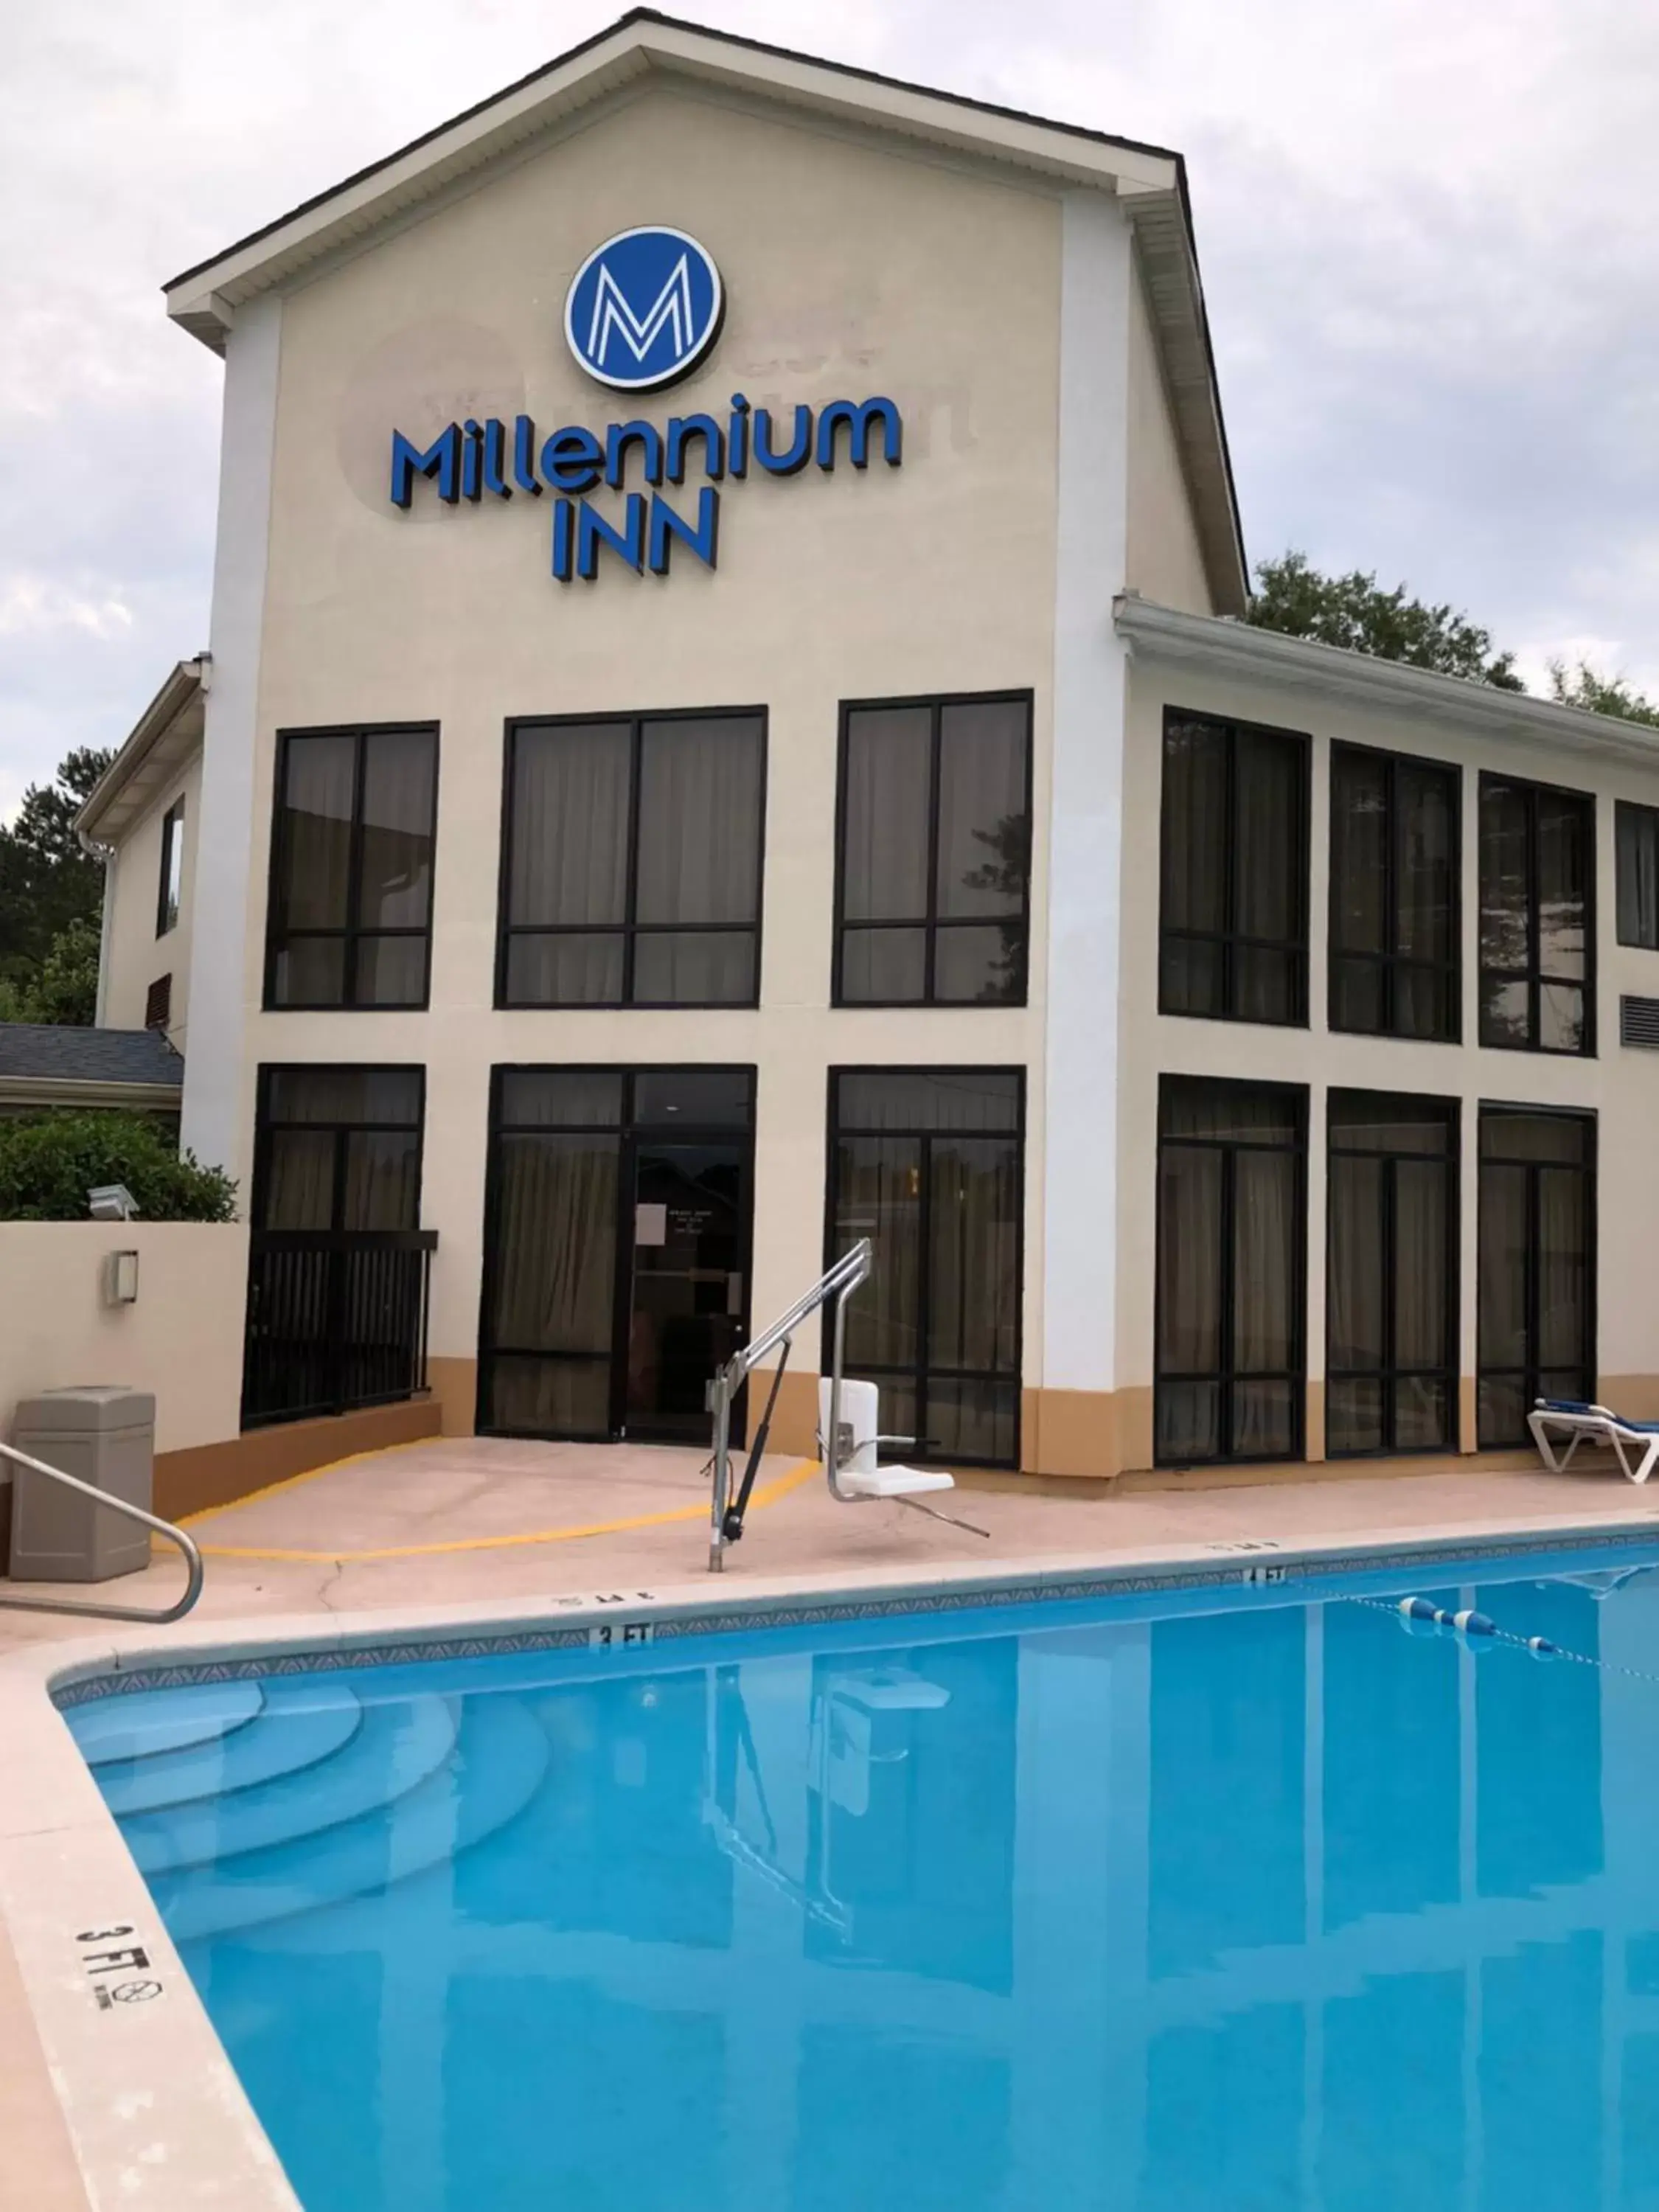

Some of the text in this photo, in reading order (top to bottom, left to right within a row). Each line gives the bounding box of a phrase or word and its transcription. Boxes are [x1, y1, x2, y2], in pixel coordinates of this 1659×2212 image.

[588, 252, 694, 366] M
[391, 393, 902, 509] Millennium
[552, 486, 720, 582] INN
[1265, 1565, 1284, 1581] FT
[624, 1623, 650, 1642] FT
[75, 1926, 150, 1975] 3 FT
